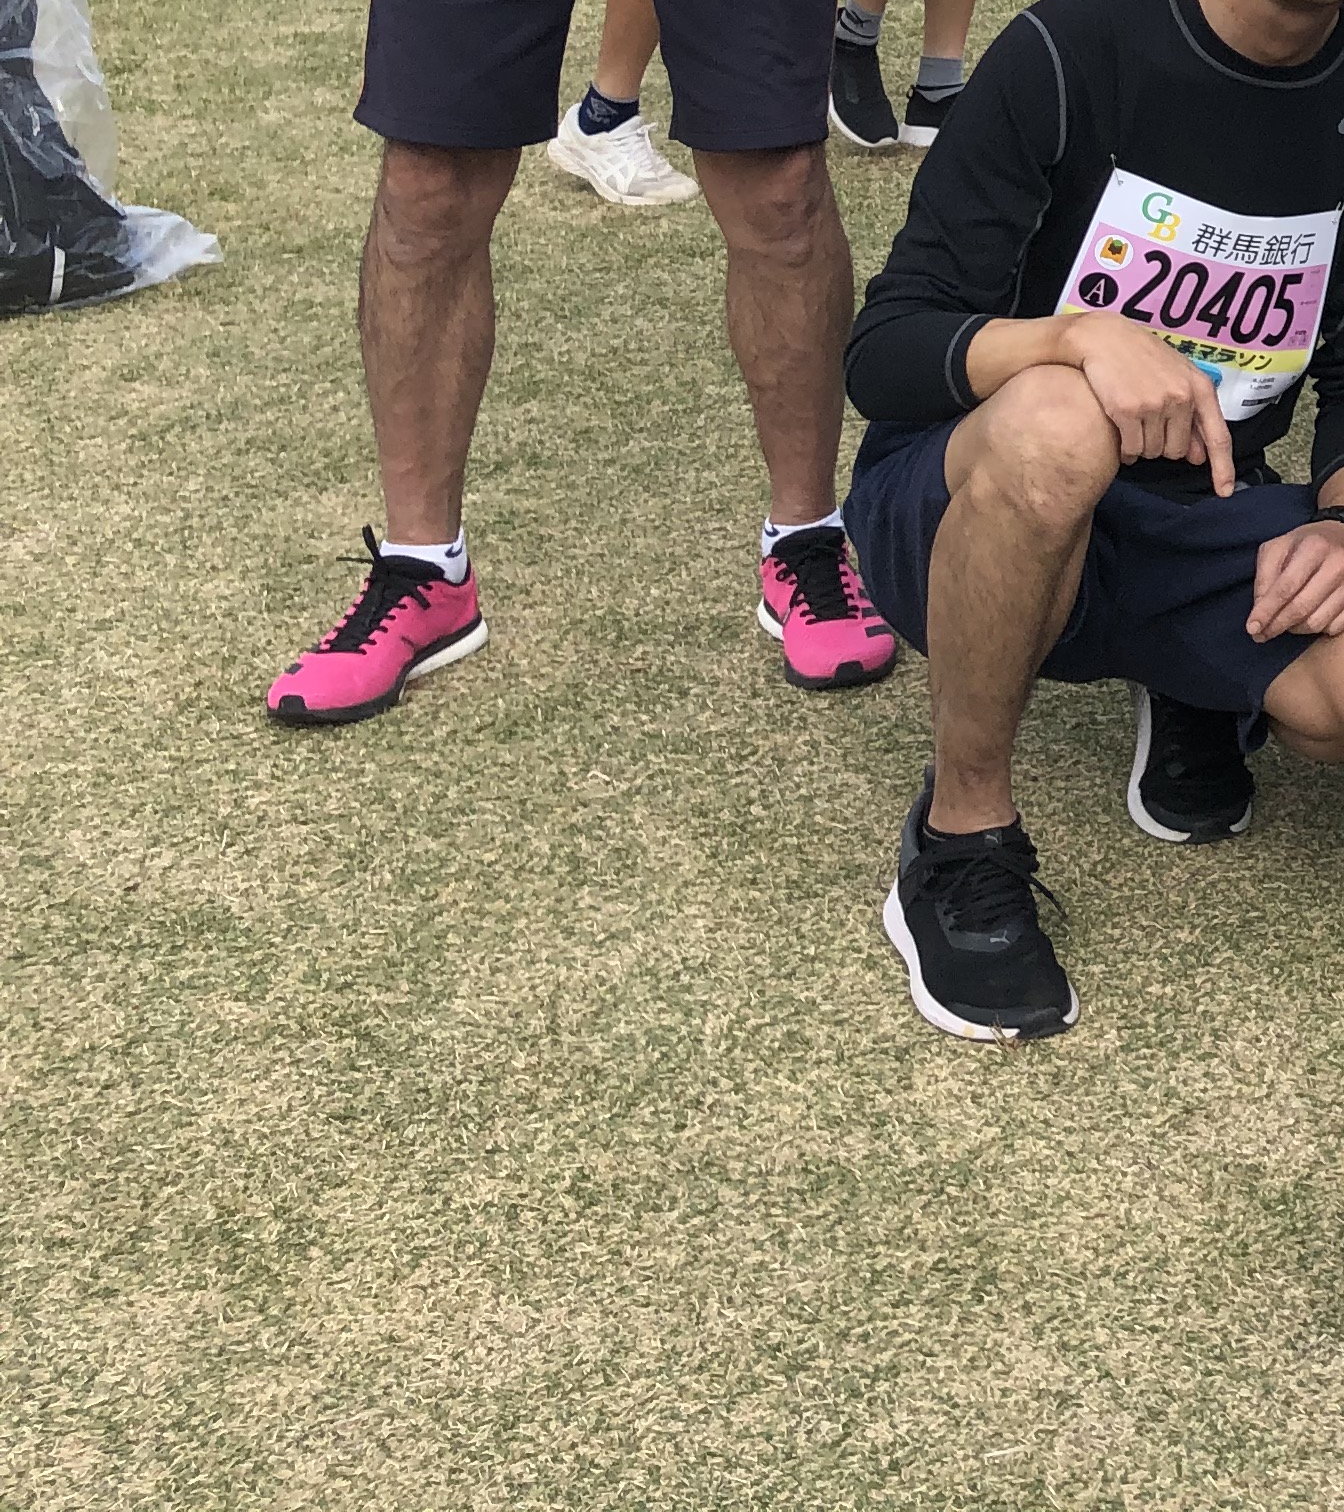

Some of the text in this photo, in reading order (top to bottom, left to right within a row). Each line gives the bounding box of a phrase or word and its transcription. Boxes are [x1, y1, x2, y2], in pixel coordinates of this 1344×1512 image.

[1191, 223, 1316, 266] 群馬銀行
[1121, 249, 1305, 347] 20405
